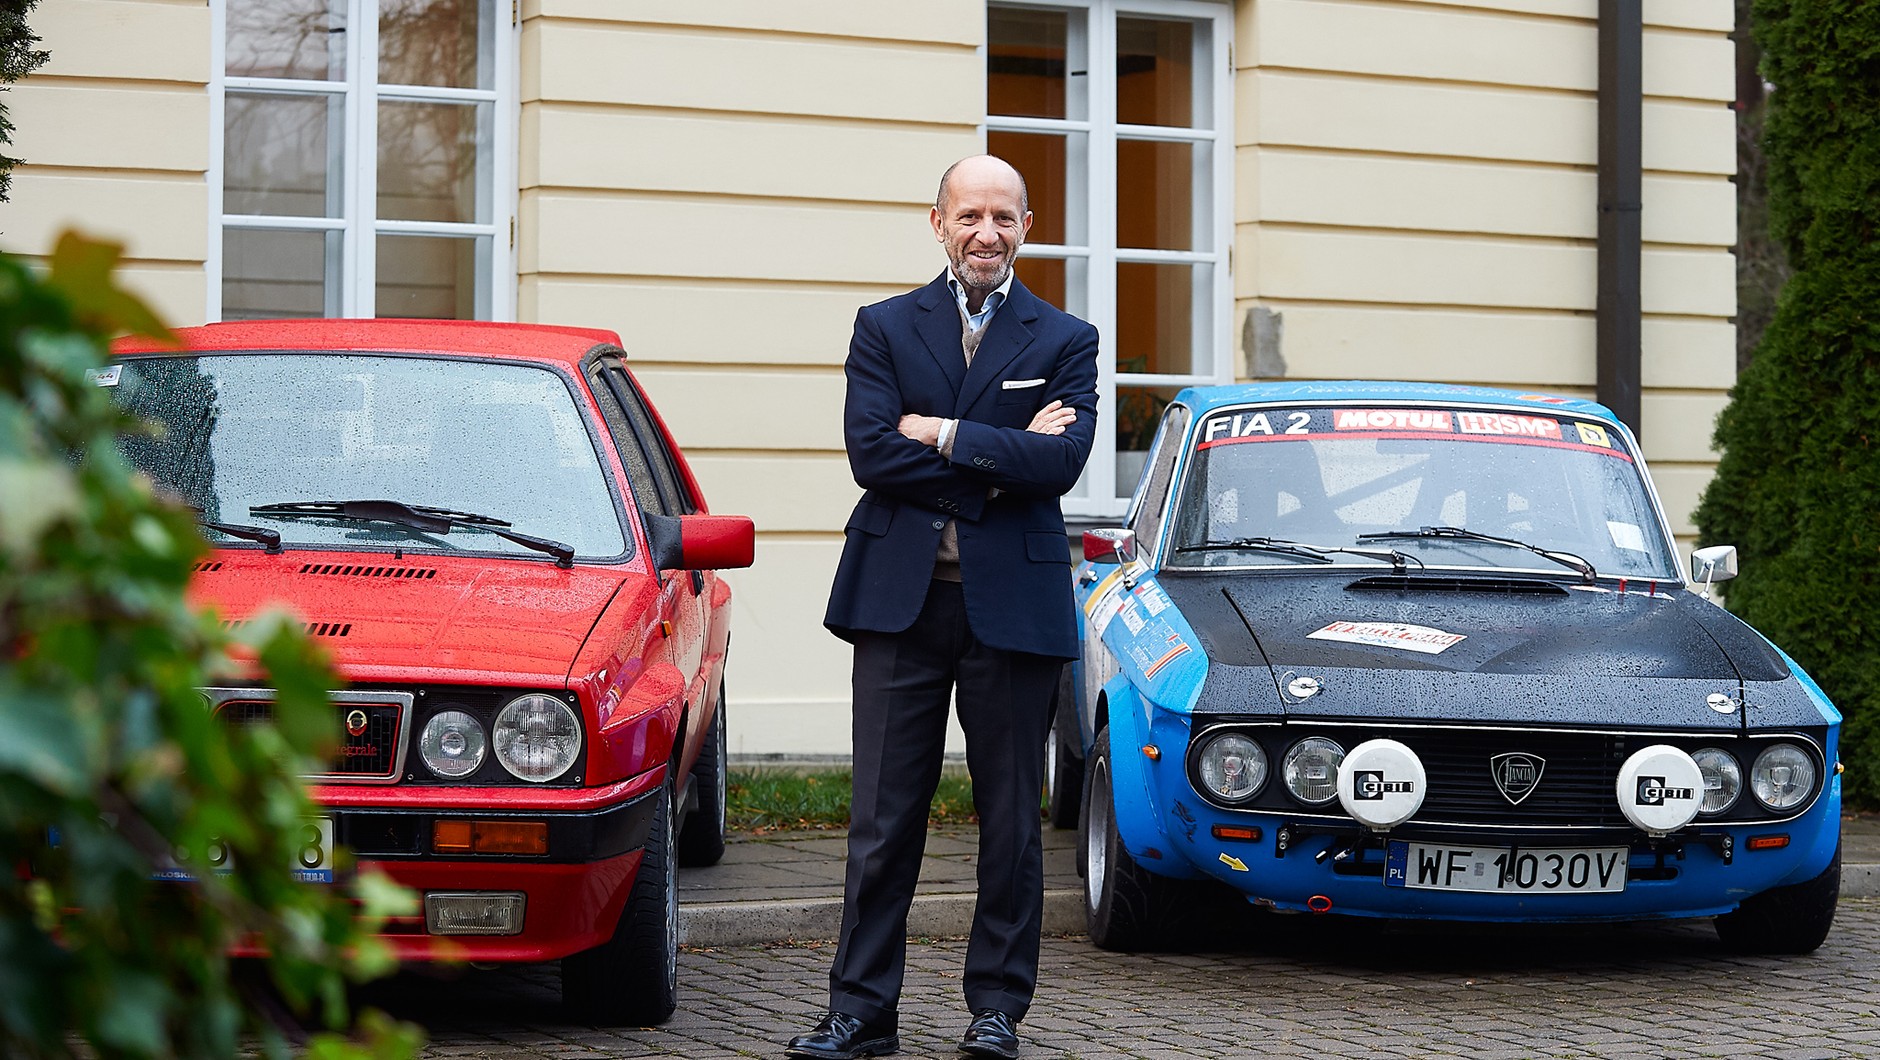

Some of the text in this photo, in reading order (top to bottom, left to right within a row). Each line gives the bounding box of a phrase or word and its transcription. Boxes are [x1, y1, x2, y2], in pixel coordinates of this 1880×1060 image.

[1205, 412, 1311, 442] FIA 2
[1338, 411, 1449, 429] MOTUL
[336, 743, 377, 757] tegrale
[1509, 766, 1531, 782] LANCIA
[1389, 868, 1404, 879] PL
[1418, 848, 1618, 889] WF 1030V
